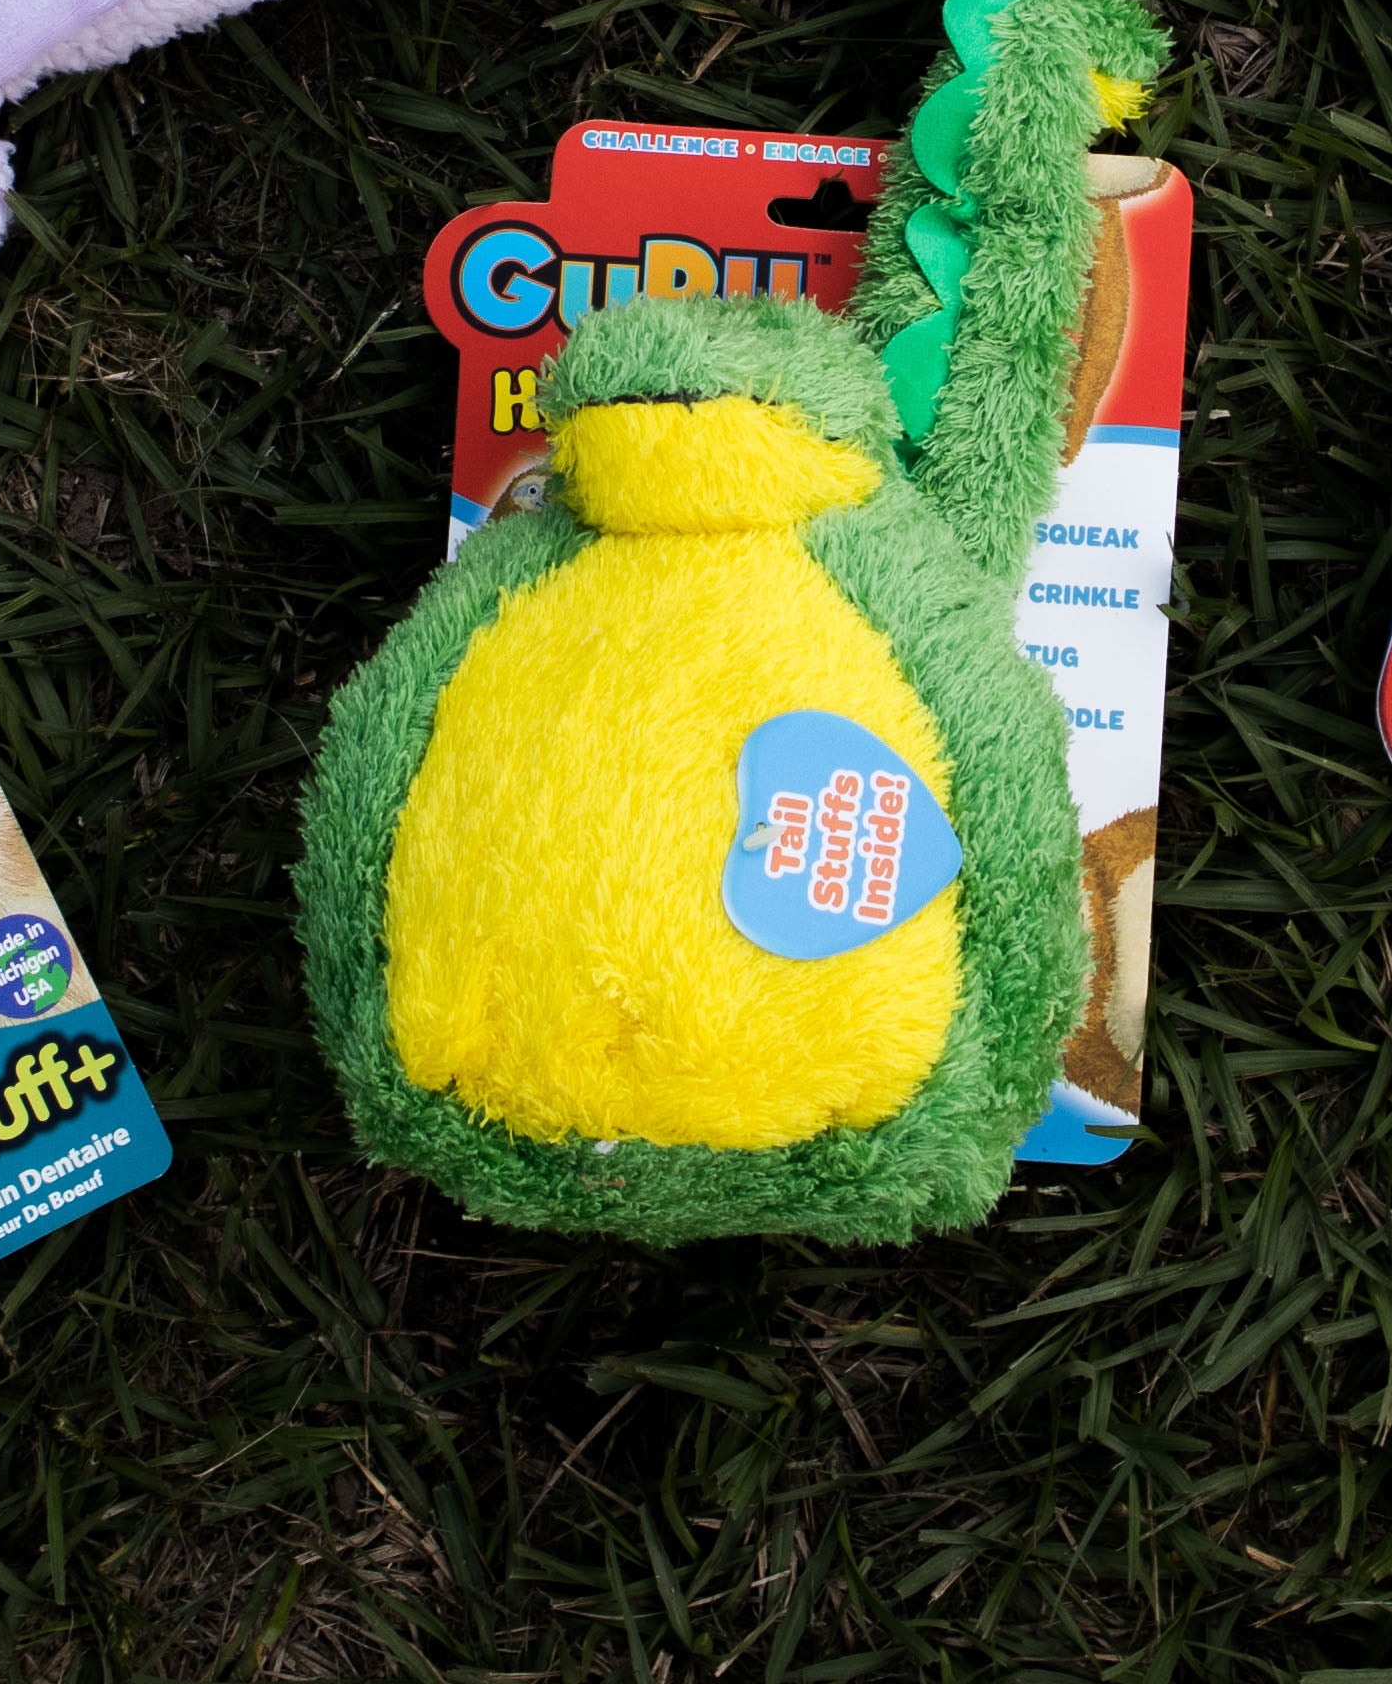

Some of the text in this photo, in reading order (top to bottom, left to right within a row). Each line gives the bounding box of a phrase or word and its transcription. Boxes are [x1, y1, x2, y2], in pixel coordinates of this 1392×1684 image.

[581, 129, 871, 166] CHALLENGE ENGAGE
[1033, 522, 1139, 548] SQUEAK
[1028, 582, 1139, 609] CRINKLE
[1025, 644, 1078, 667] TUG
[767, 797, 808, 876] Tail
[807, 771, 858, 907] Stuffs
[851, 775, 905, 919] Inside!
[24, 922, 44, 939] in
[11, 978, 52, 1005] USA
[18, 1127, 130, 1194] Dentaire
[21, 1202, 50, 1223] De
[47, 1168, 103, 1209] Boeuf
